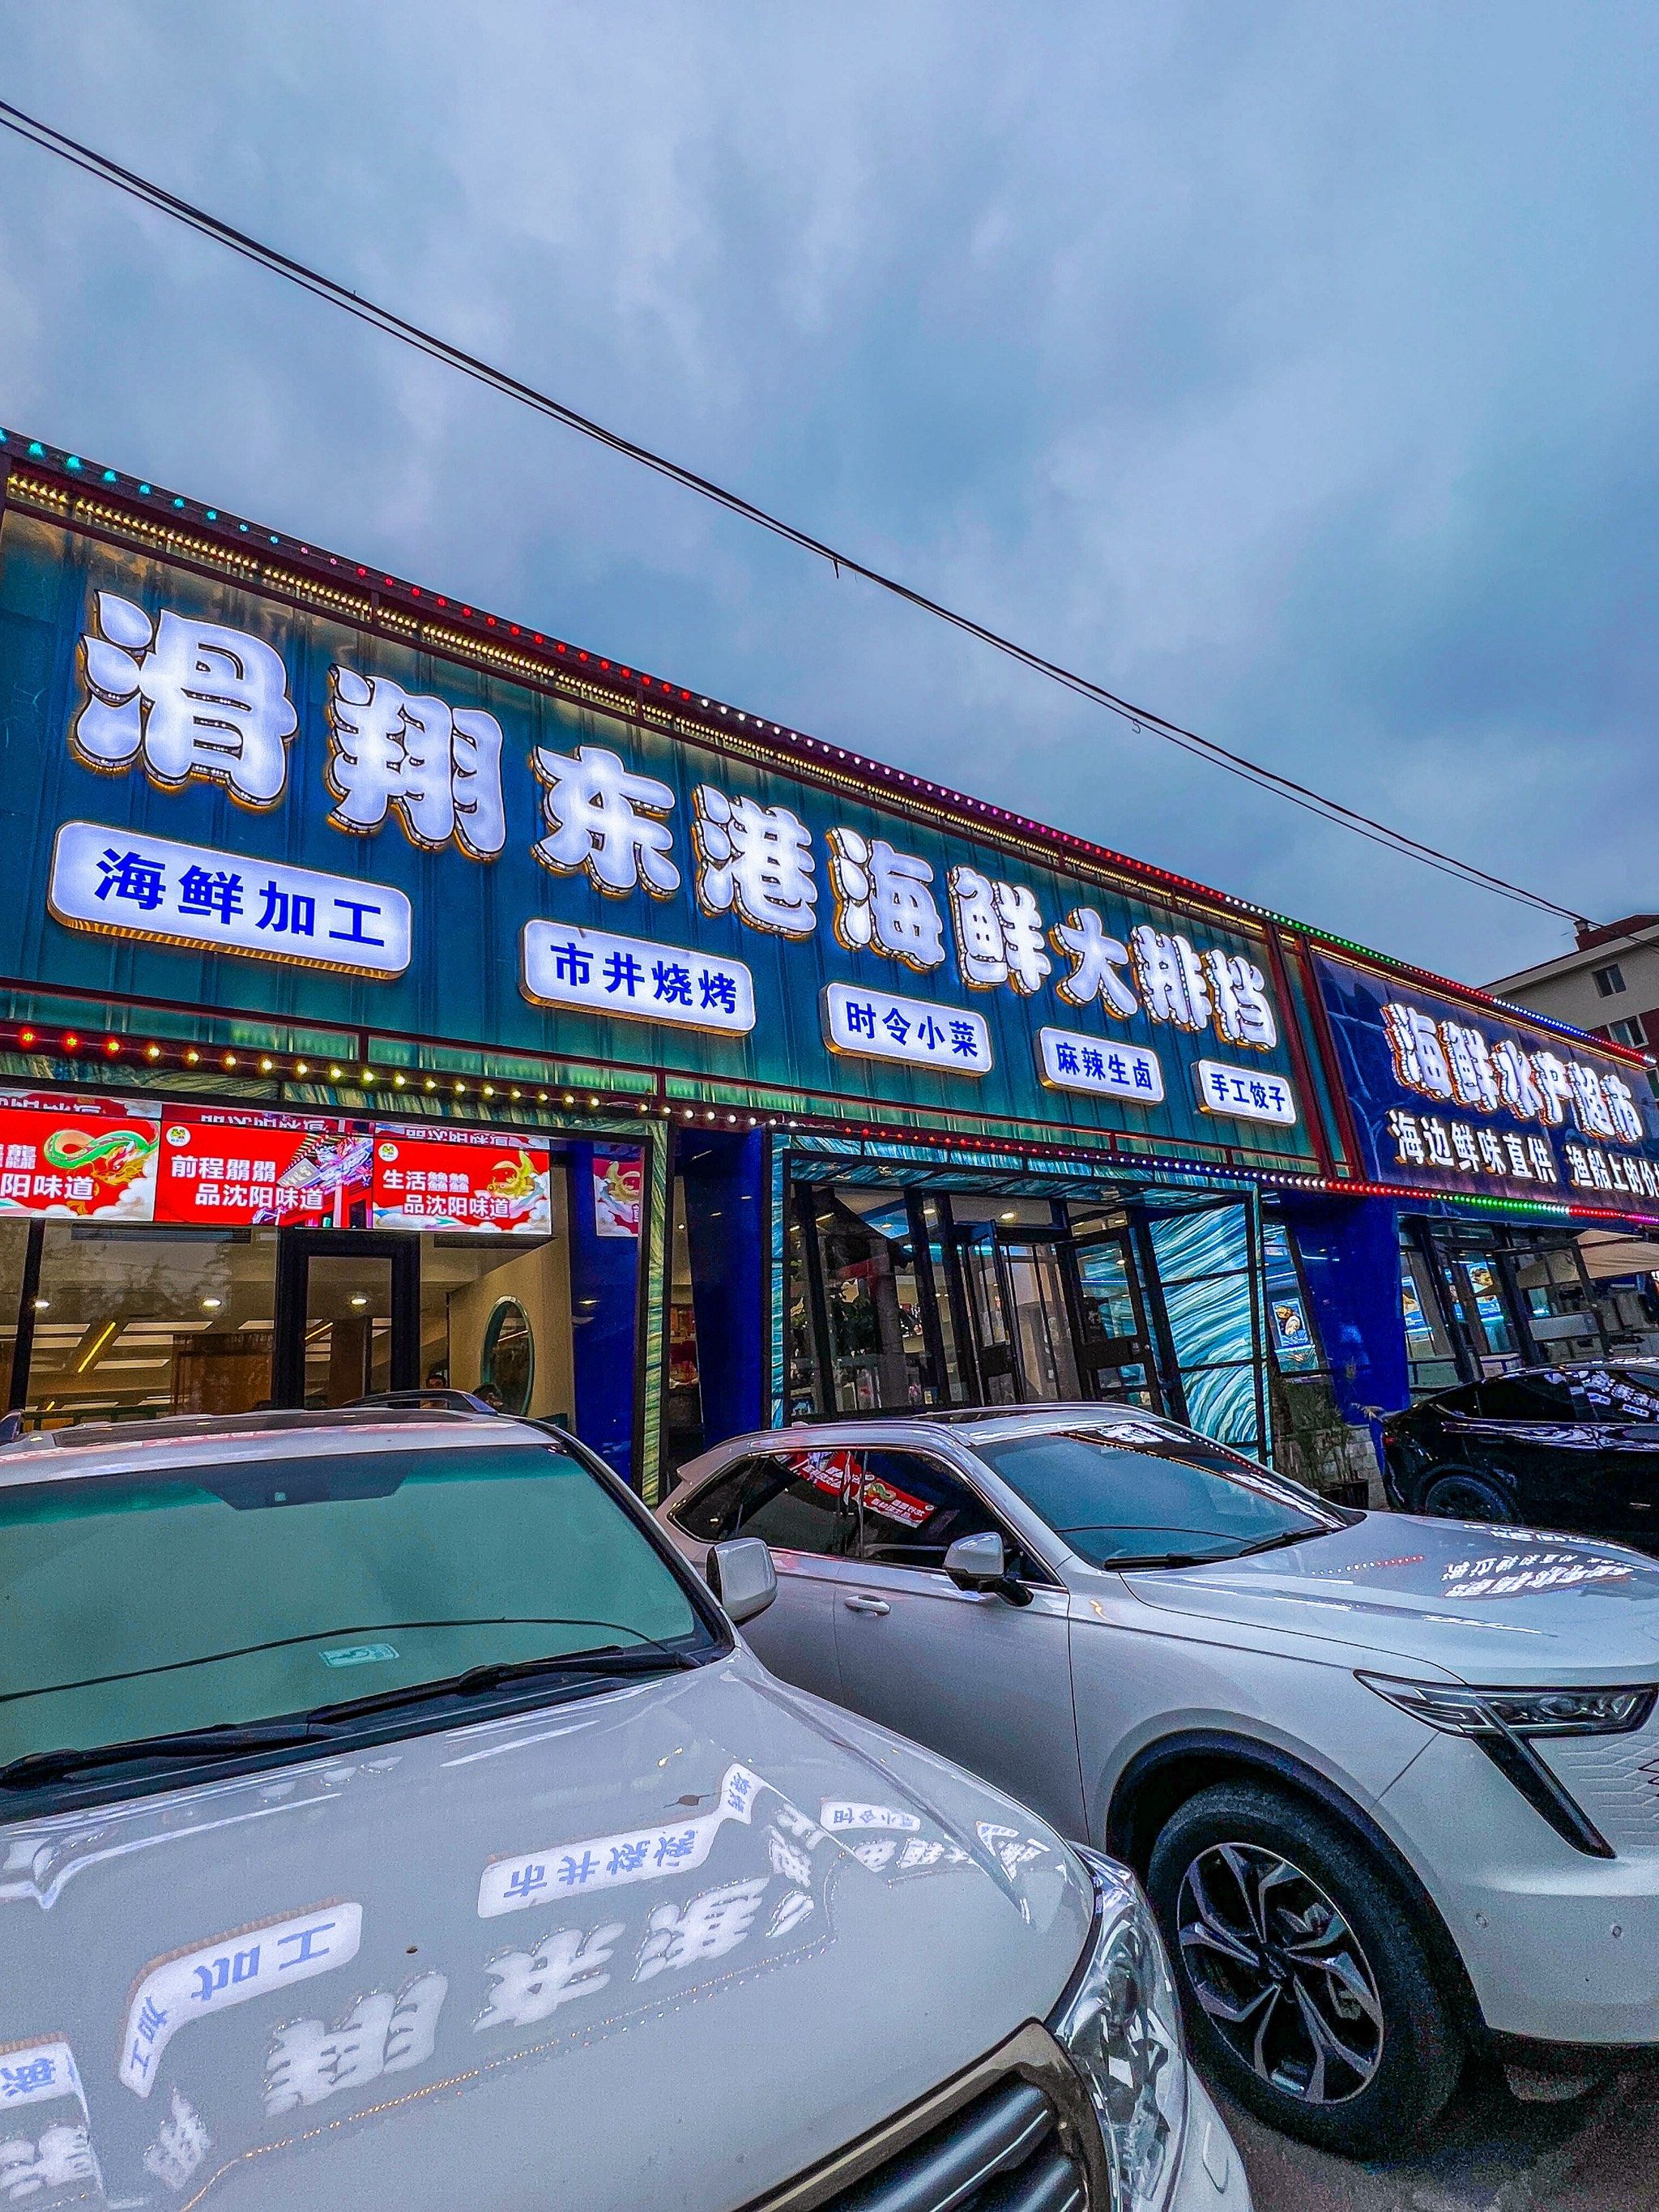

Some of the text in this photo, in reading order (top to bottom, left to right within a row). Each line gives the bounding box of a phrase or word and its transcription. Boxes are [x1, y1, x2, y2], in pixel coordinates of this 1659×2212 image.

[75, 590, 1277, 1052] 滑翔东港海鲜大排档
[93, 848, 386, 948] 海鲜加工
[549, 941, 738, 1014] 市井烧烤
[845, 1001, 979, 1058] 时令小菜
[1055, 1041, 1154, 1091] 麻辣生卤
[1210, 1073, 1286, 1112] 手工饺子
[1381, 1003, 1644, 1144] 海鲜水产超市
[1388, 1109, 1659, 1198] 海边鲜味直供 渔船上的价
[0, 1172, 95, 1201] 阳味道
[194, 1182, 324, 1211] 品沈阳味道
[403, 1194, 510, 1219] 品沈阳味道
